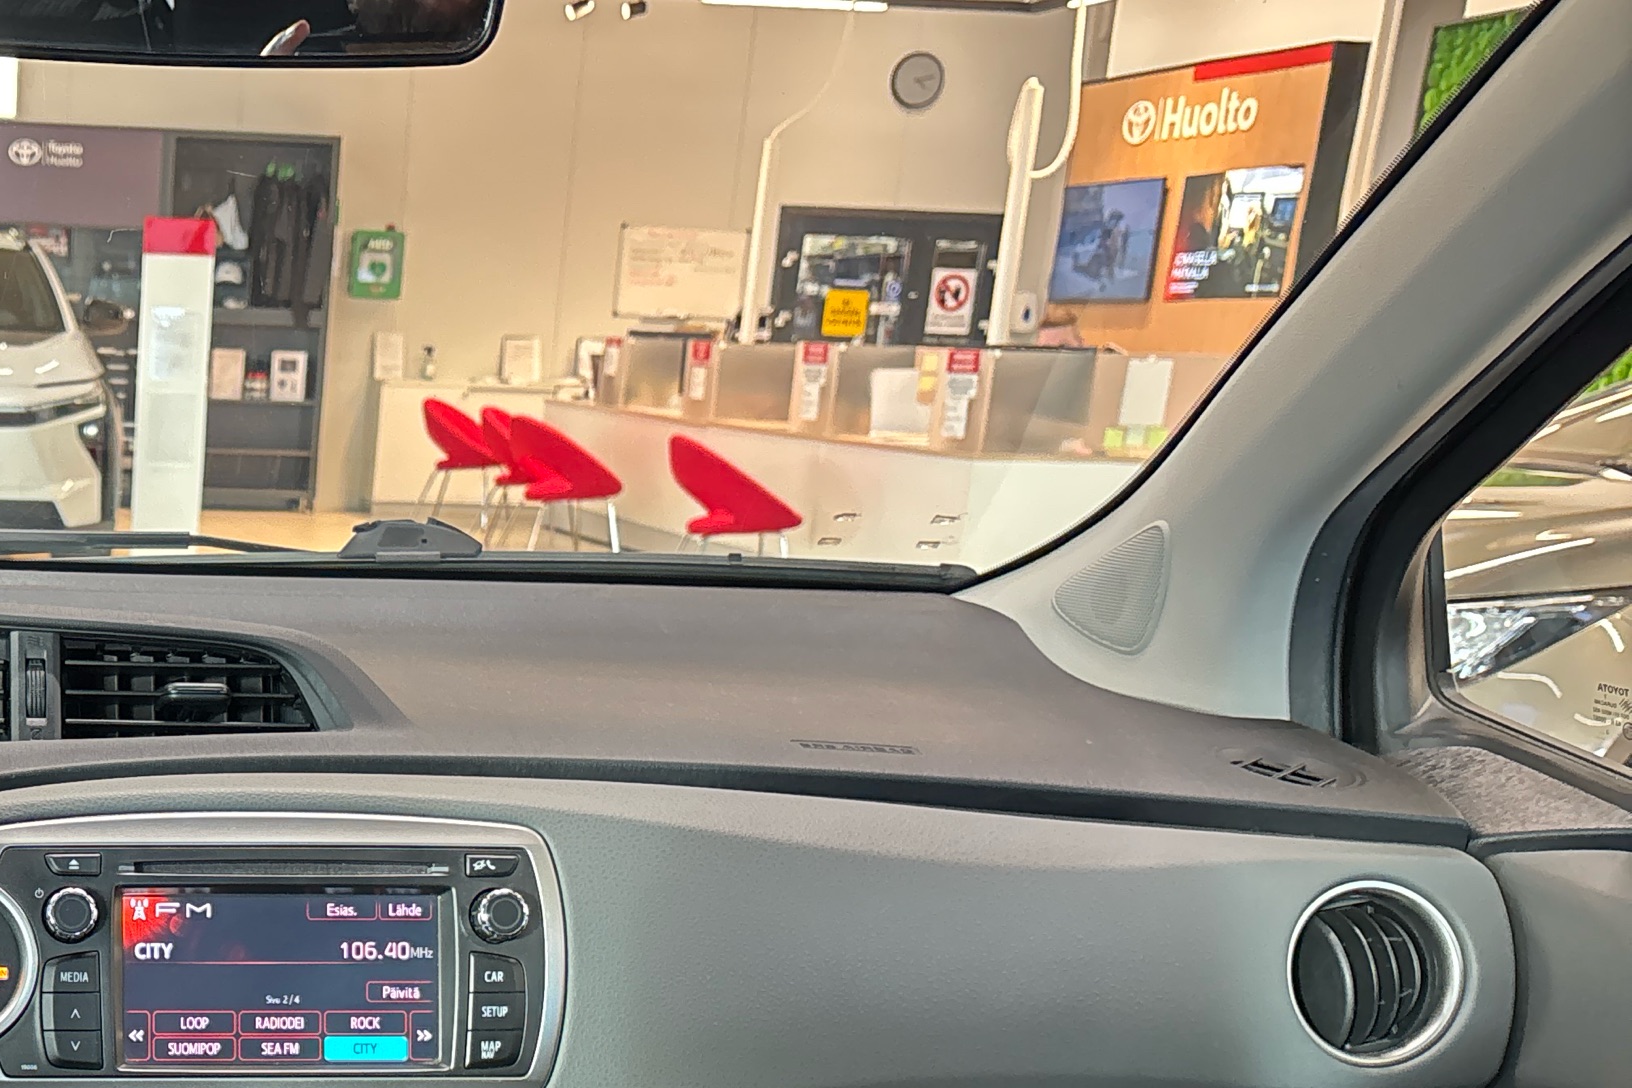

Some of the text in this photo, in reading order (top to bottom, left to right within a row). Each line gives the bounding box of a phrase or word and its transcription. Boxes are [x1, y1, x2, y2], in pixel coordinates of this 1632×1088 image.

[1160, 86, 1259, 142] Huolto
[326, 903, 358, 917] Esias.
[388, 903, 422, 917] Lähde
[134, 942, 174, 960] CITY
[340, 941, 434, 961] 106.40 MHz
[60, 971, 89, 983] MEDIA
[484, 971, 504, 983] CAR
[282, 993, 301, 1006] 2/4
[481, 1005, 508, 1018] SETUP
[180, 1016, 210, 1030] LOOP
[255, 1016, 305, 1030] RADIODEI
[350, 1016, 381, 1030] ROCK
[167, 1042, 222, 1056] SUOMIPOP
[260, 1042, 301, 1056] SEA FM
[353, 1042, 378, 1055] CITY
[480, 1040, 502, 1052] MAP
